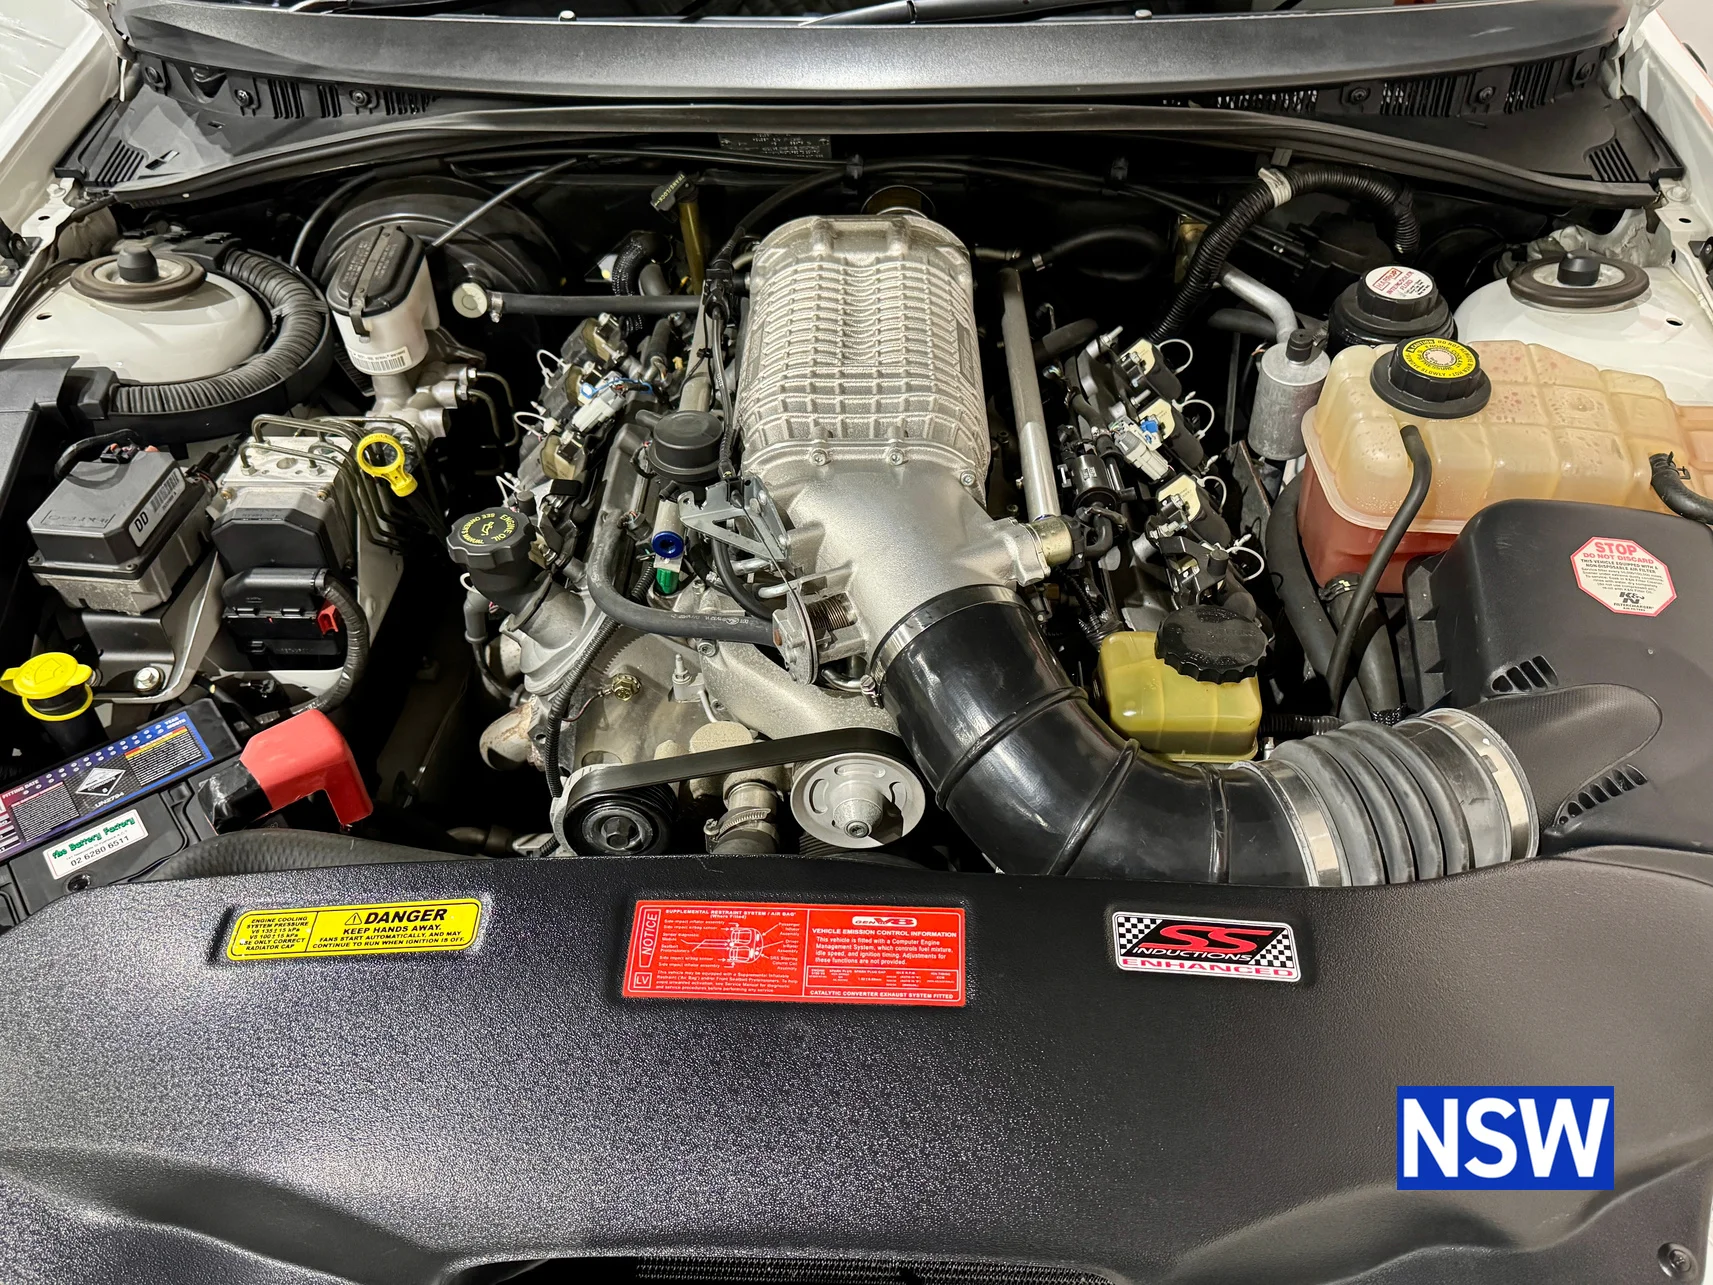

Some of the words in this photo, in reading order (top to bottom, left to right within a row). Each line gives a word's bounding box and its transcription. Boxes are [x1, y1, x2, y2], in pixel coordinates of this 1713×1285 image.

[134, 512, 148, 532] DD
[500, 514, 515, 534] ENGINE
[491, 534, 506, 542] OIL
[1594, 542, 1637, 556] STOP
[1617, 556, 1654, 564] DISCARD
[95, 792, 124, 807] UN2794
[68, 833, 102, 851] Battery
[103, 817, 135, 835] Factory
[71, 857, 82, 866] 02
[84, 846, 106, 859] 6280
[108, 836, 129, 848] 6511
[364, 909, 448, 924] DANGER
[343, 927, 370, 935] KEEP
[642, 914, 657, 955] NOTICE
[1138, 925, 1273, 954] SS
[1132, 947, 1253, 961] INDUCTIONS
[1122, 958, 1293, 976] ENHANCED
[636, 976, 649, 984] LV
